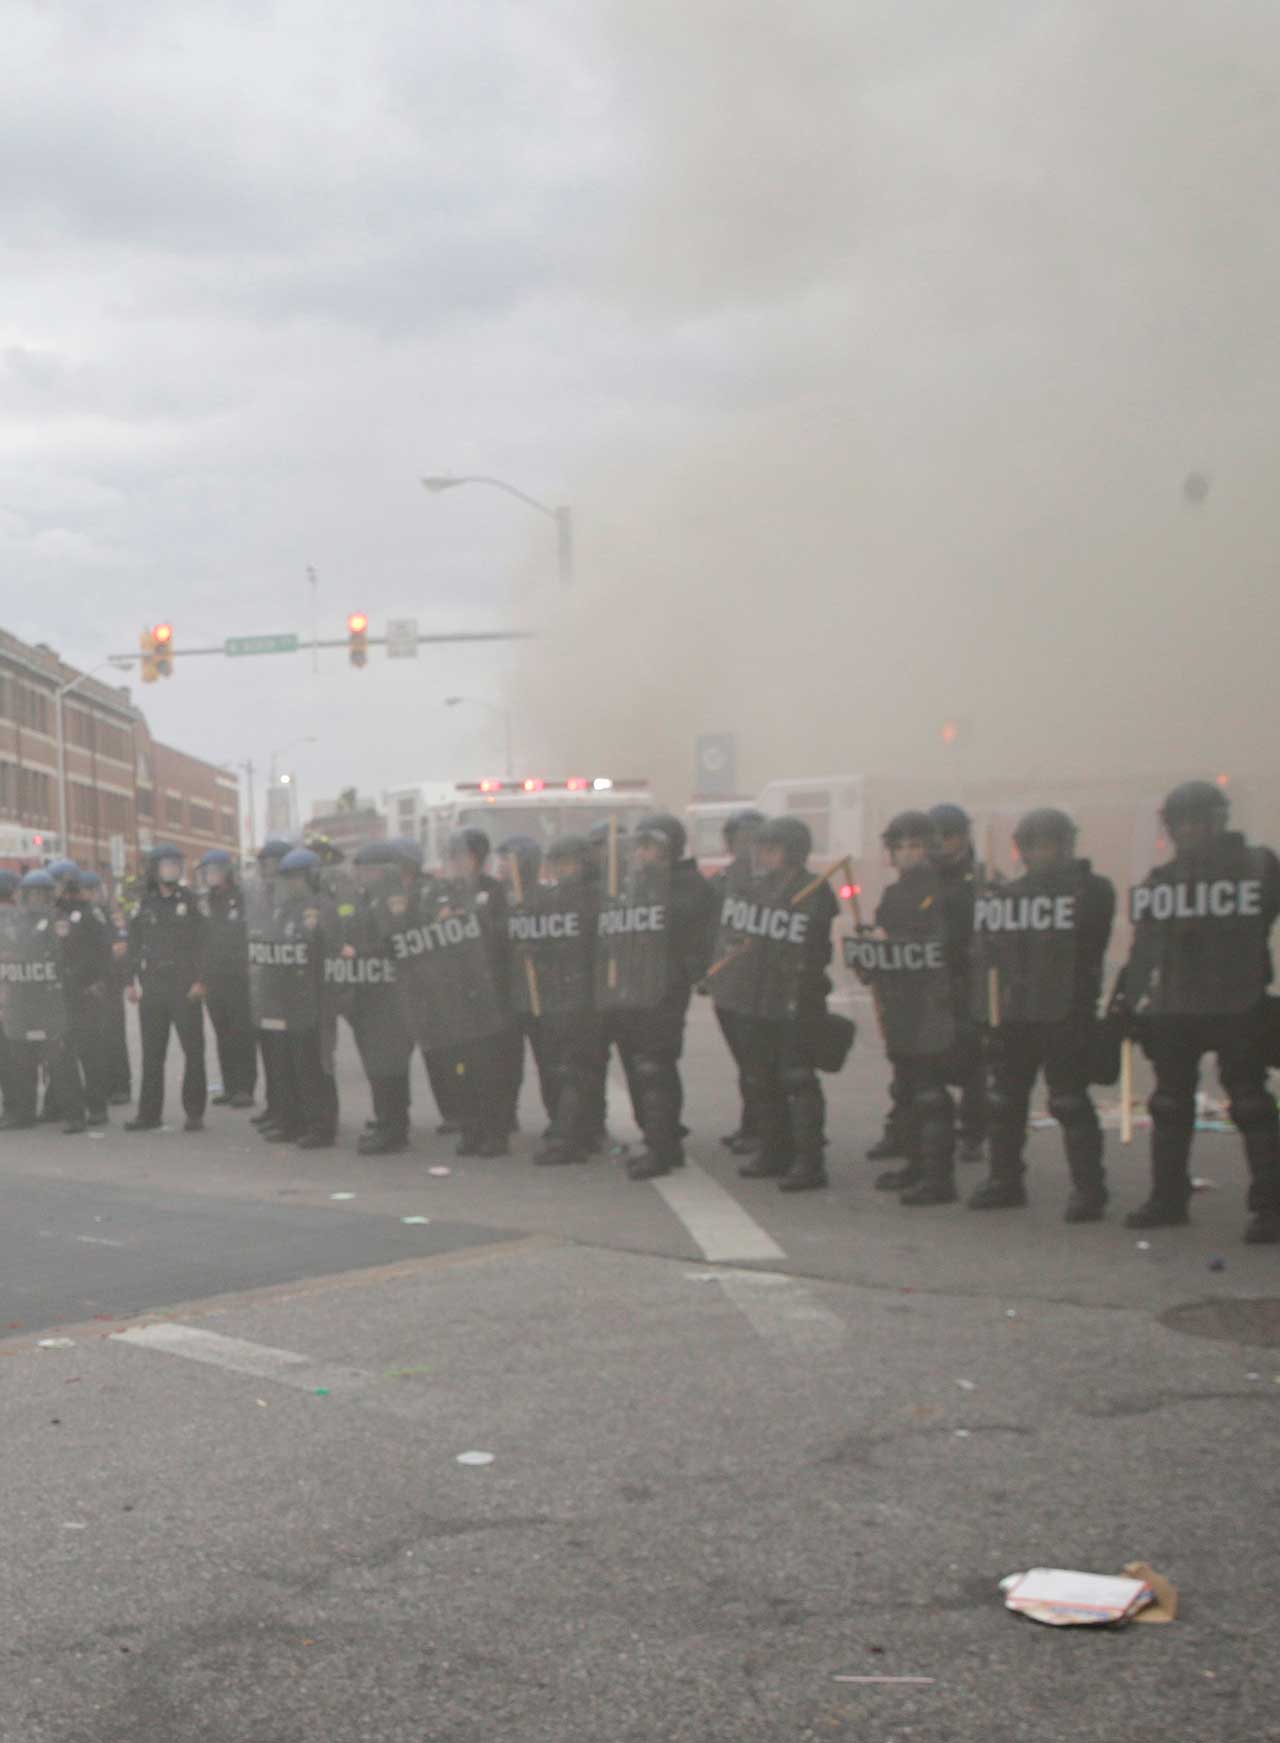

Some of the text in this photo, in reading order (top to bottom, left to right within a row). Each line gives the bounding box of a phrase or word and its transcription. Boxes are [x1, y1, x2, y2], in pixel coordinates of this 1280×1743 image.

[973, 896, 1074, 931] POLICE
[1131, 880, 1261, 921] POLICE
[392, 913, 481, 959] POLICE
[508, 912, 579, 939] POLICE
[598, 905, 666, 936] POLICE
[720, 897, 810, 944] POLICE
[248, 942, 308, 965] POLICE
[845, 938, 946, 969] POLICE
[0, 961, 57, 982] POLICE
